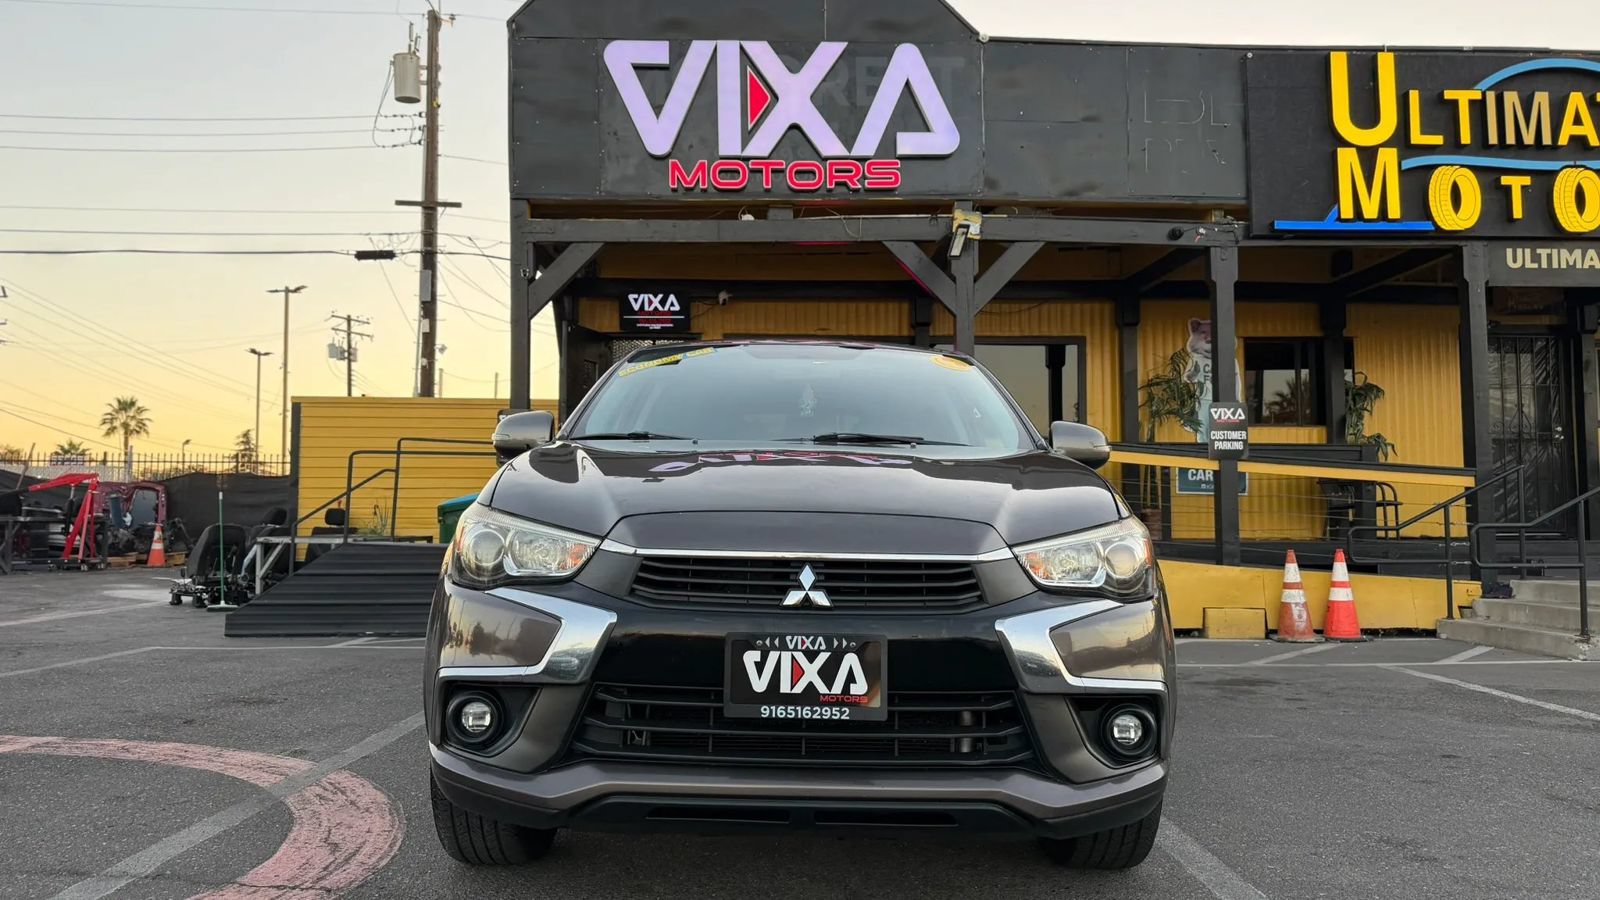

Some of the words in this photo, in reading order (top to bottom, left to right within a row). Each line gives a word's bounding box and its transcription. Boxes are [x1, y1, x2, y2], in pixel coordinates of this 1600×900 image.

[603, 39, 961, 158] VIXA
[1329, 51, 1600, 147] ULTIMA
[668, 159, 902, 192] MOTORS
[627, 293, 681, 312] VIXA
[1210, 407, 1246, 420] VIXA
[1210, 430, 1247, 440] CUSTOMER
[1214, 440, 1244, 450] PARKING
[785, 635, 827, 650] VIXA
[742, 650, 868, 695] VIXA
[819, 694, 869, 703] MOTORS
[760, 705, 850, 720] 9165162952
